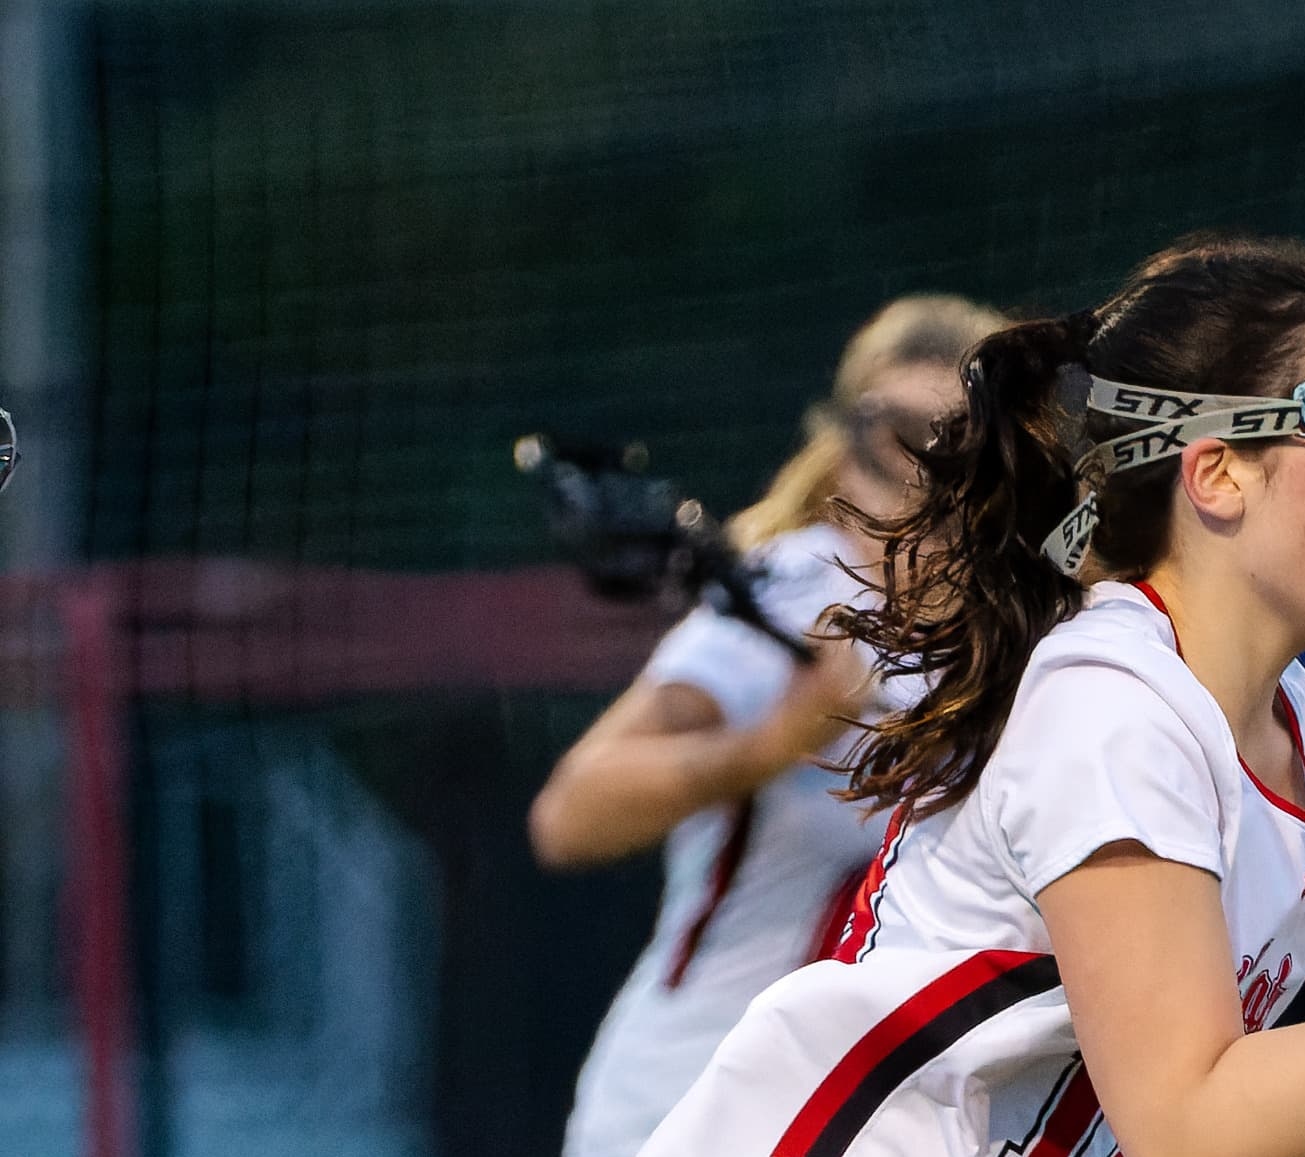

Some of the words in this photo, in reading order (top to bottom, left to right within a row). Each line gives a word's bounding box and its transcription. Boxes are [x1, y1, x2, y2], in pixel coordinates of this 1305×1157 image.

[1111, 388, 1203, 419] STX
[1231, 406, 1301, 434] ST
[1112, 424, 1189, 467] STX
